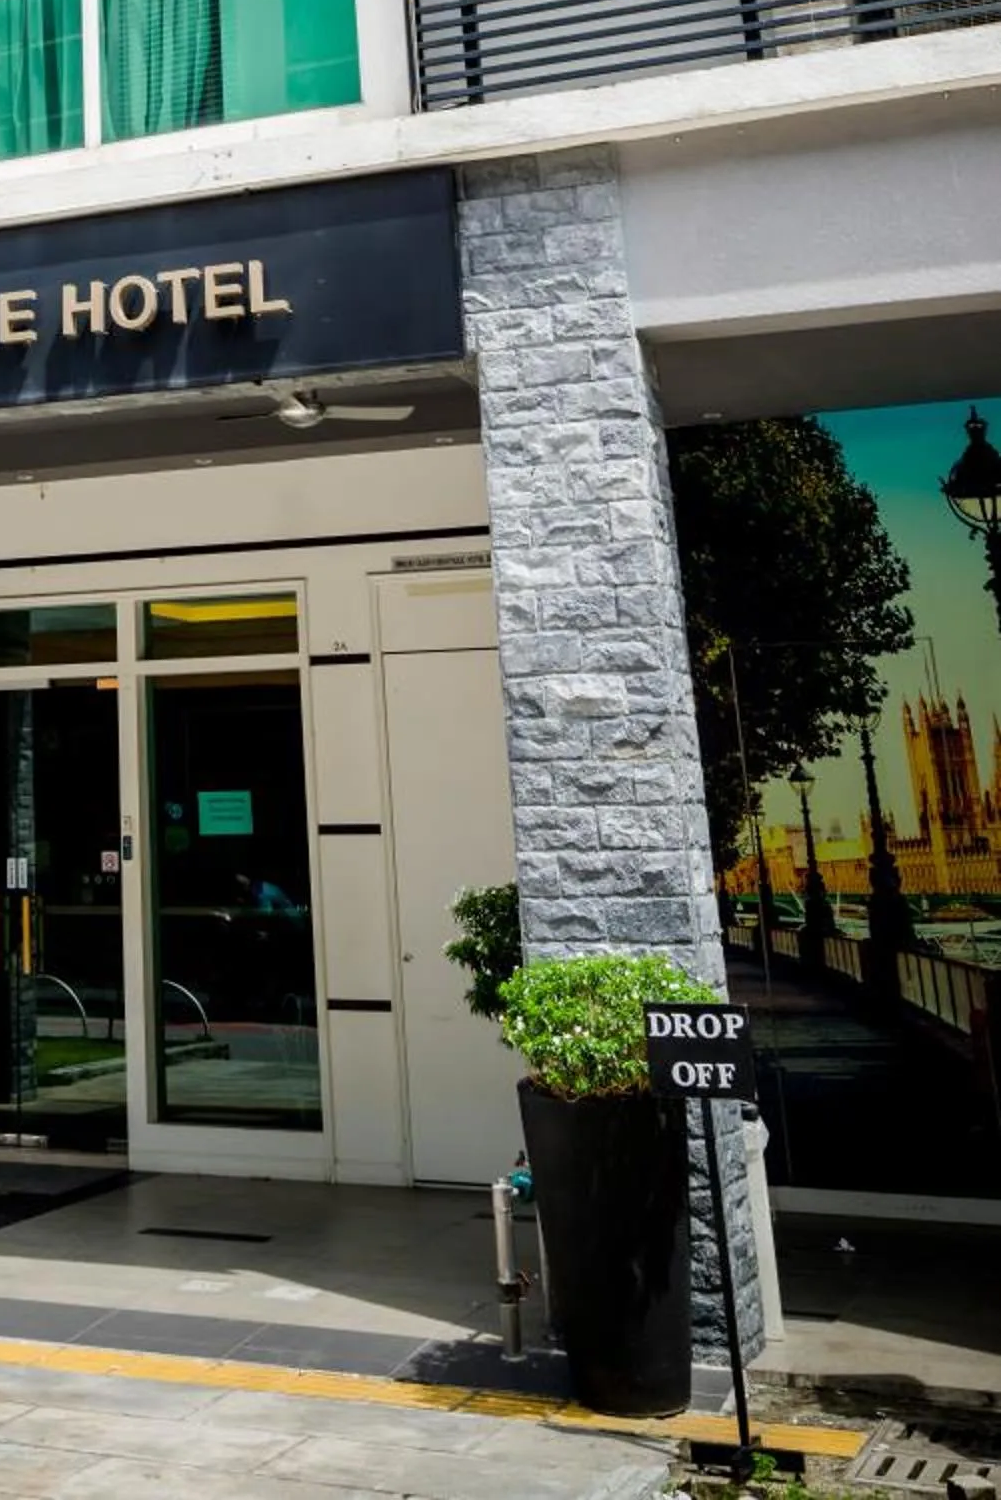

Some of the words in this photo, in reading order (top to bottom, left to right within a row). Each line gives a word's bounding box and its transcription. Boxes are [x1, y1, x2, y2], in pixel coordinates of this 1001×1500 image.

[62, 259, 293, 336] HOTEL
[647, 1012, 744, 1039] DROP
[671, 1061, 736, 1089] OFF
